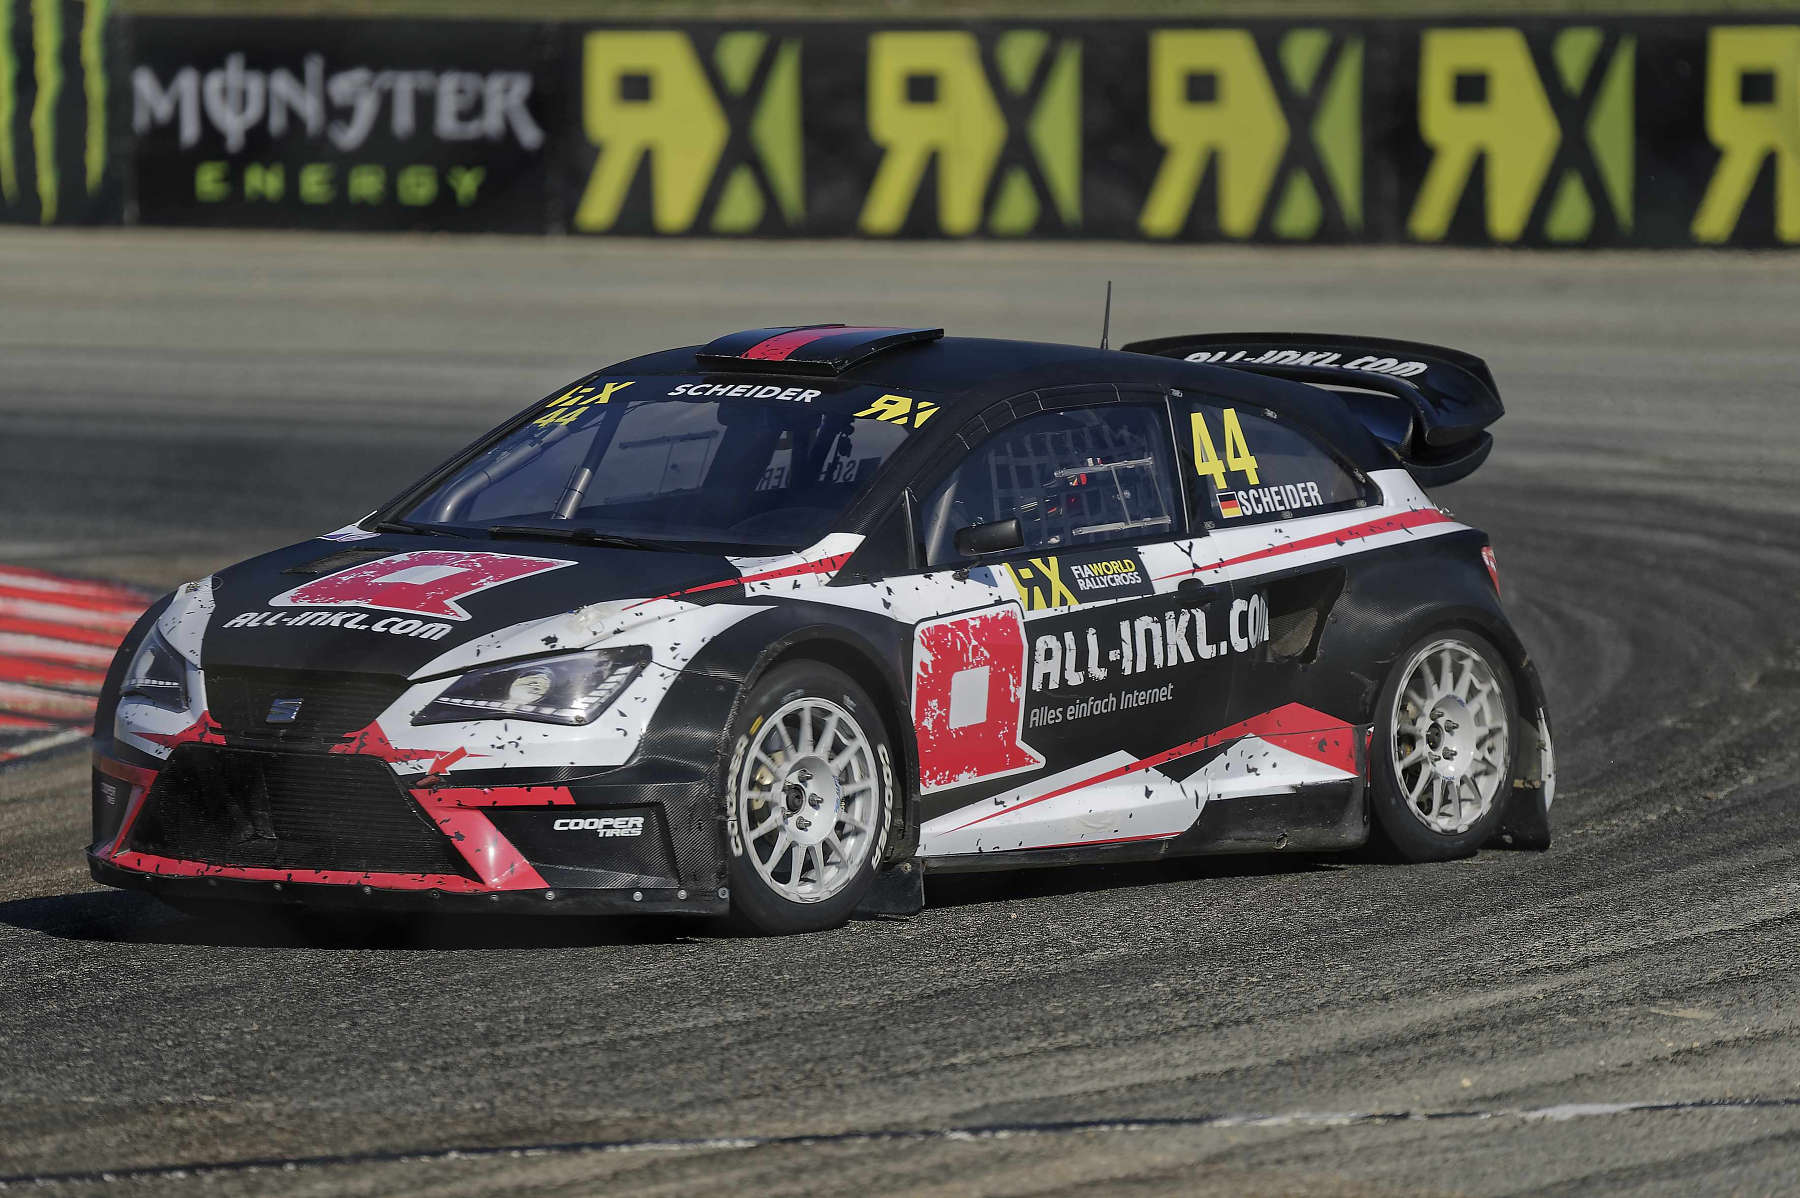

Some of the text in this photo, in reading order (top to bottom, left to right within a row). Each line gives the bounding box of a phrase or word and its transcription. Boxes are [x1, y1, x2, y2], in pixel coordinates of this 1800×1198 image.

[132, 53, 543, 153] MONSTER
[195, 161, 485, 206] ENERGY
[667, 383, 822, 403] SCHEIDER
[1191, 407, 1260, 490] 44
[1238, 481, 1324, 517] SCHEIDER
[1077, 571, 1142, 591] RALLYCROSS
[222, 610, 453, 641] ALL-INKL.COM
[1029, 682, 1174, 729] Alles einfach Internet
[553, 816, 644, 831] COOPER
[597, 827, 643, 838] TIRES
